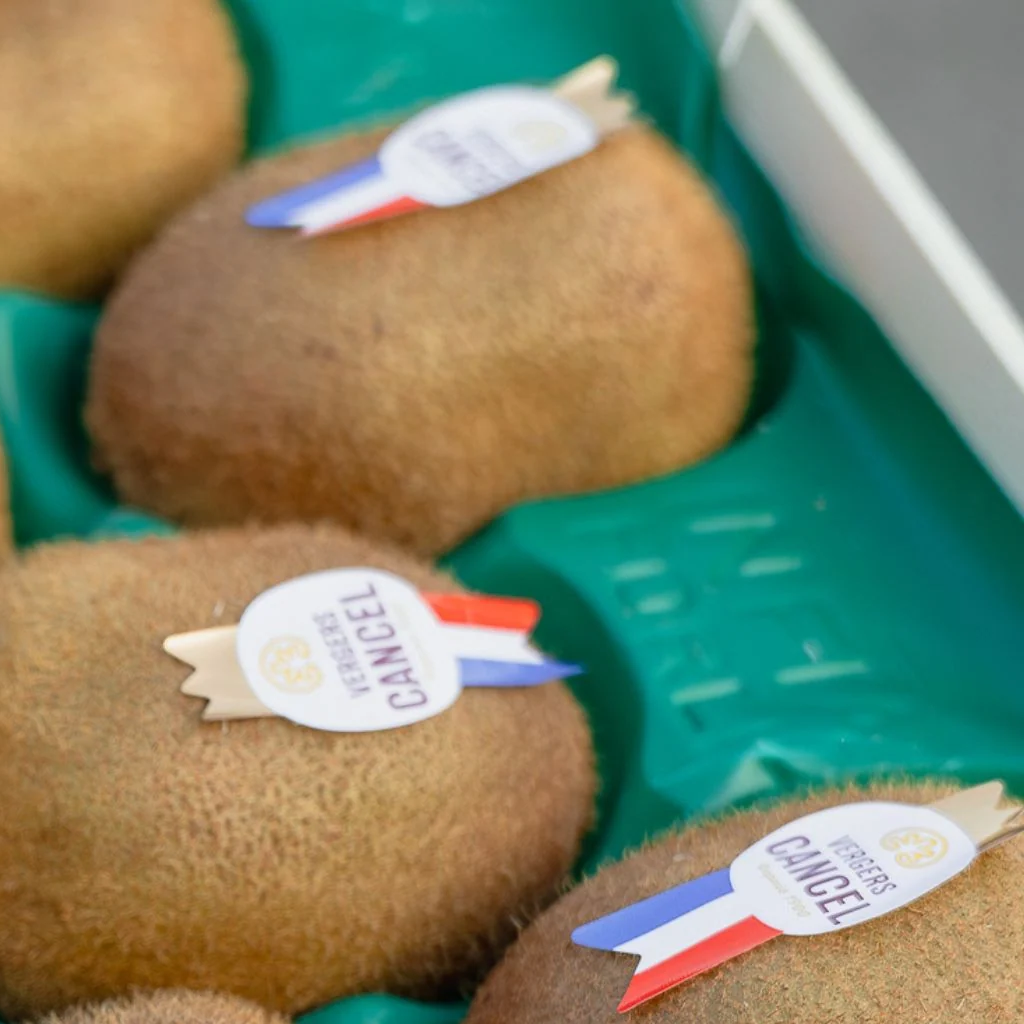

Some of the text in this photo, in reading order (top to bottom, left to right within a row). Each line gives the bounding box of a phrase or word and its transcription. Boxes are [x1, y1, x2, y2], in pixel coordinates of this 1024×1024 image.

[312, 610, 372, 700] VERGERS
[338, 581, 429, 711] CANCEL
[765, 834, 871, 926] CANCEL
[826, 833, 897, 896] VERGERS
